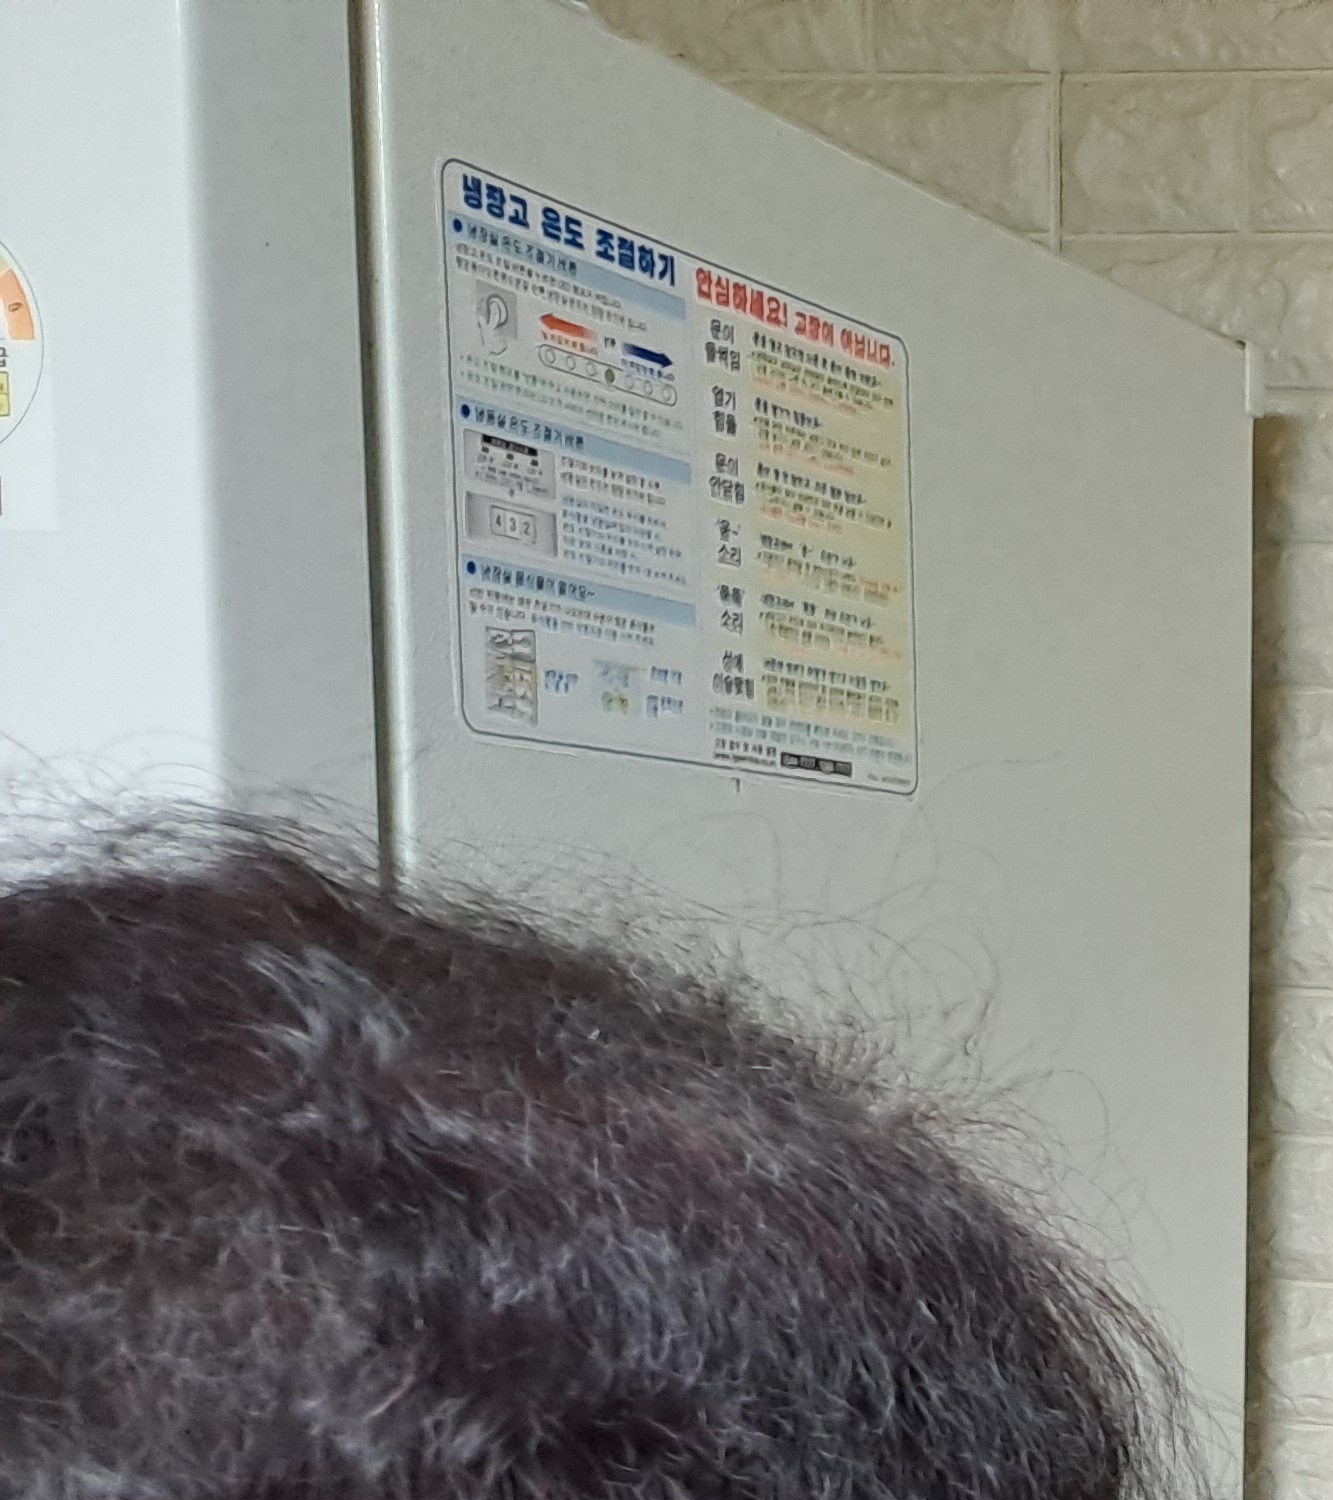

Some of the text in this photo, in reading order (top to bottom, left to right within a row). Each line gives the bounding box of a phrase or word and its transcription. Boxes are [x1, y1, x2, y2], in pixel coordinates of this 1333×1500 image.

[463, 174, 530, 230] 냉장고
[541, 207, 586, 250] 온도
[595, 228, 675, 288] 조절하기
